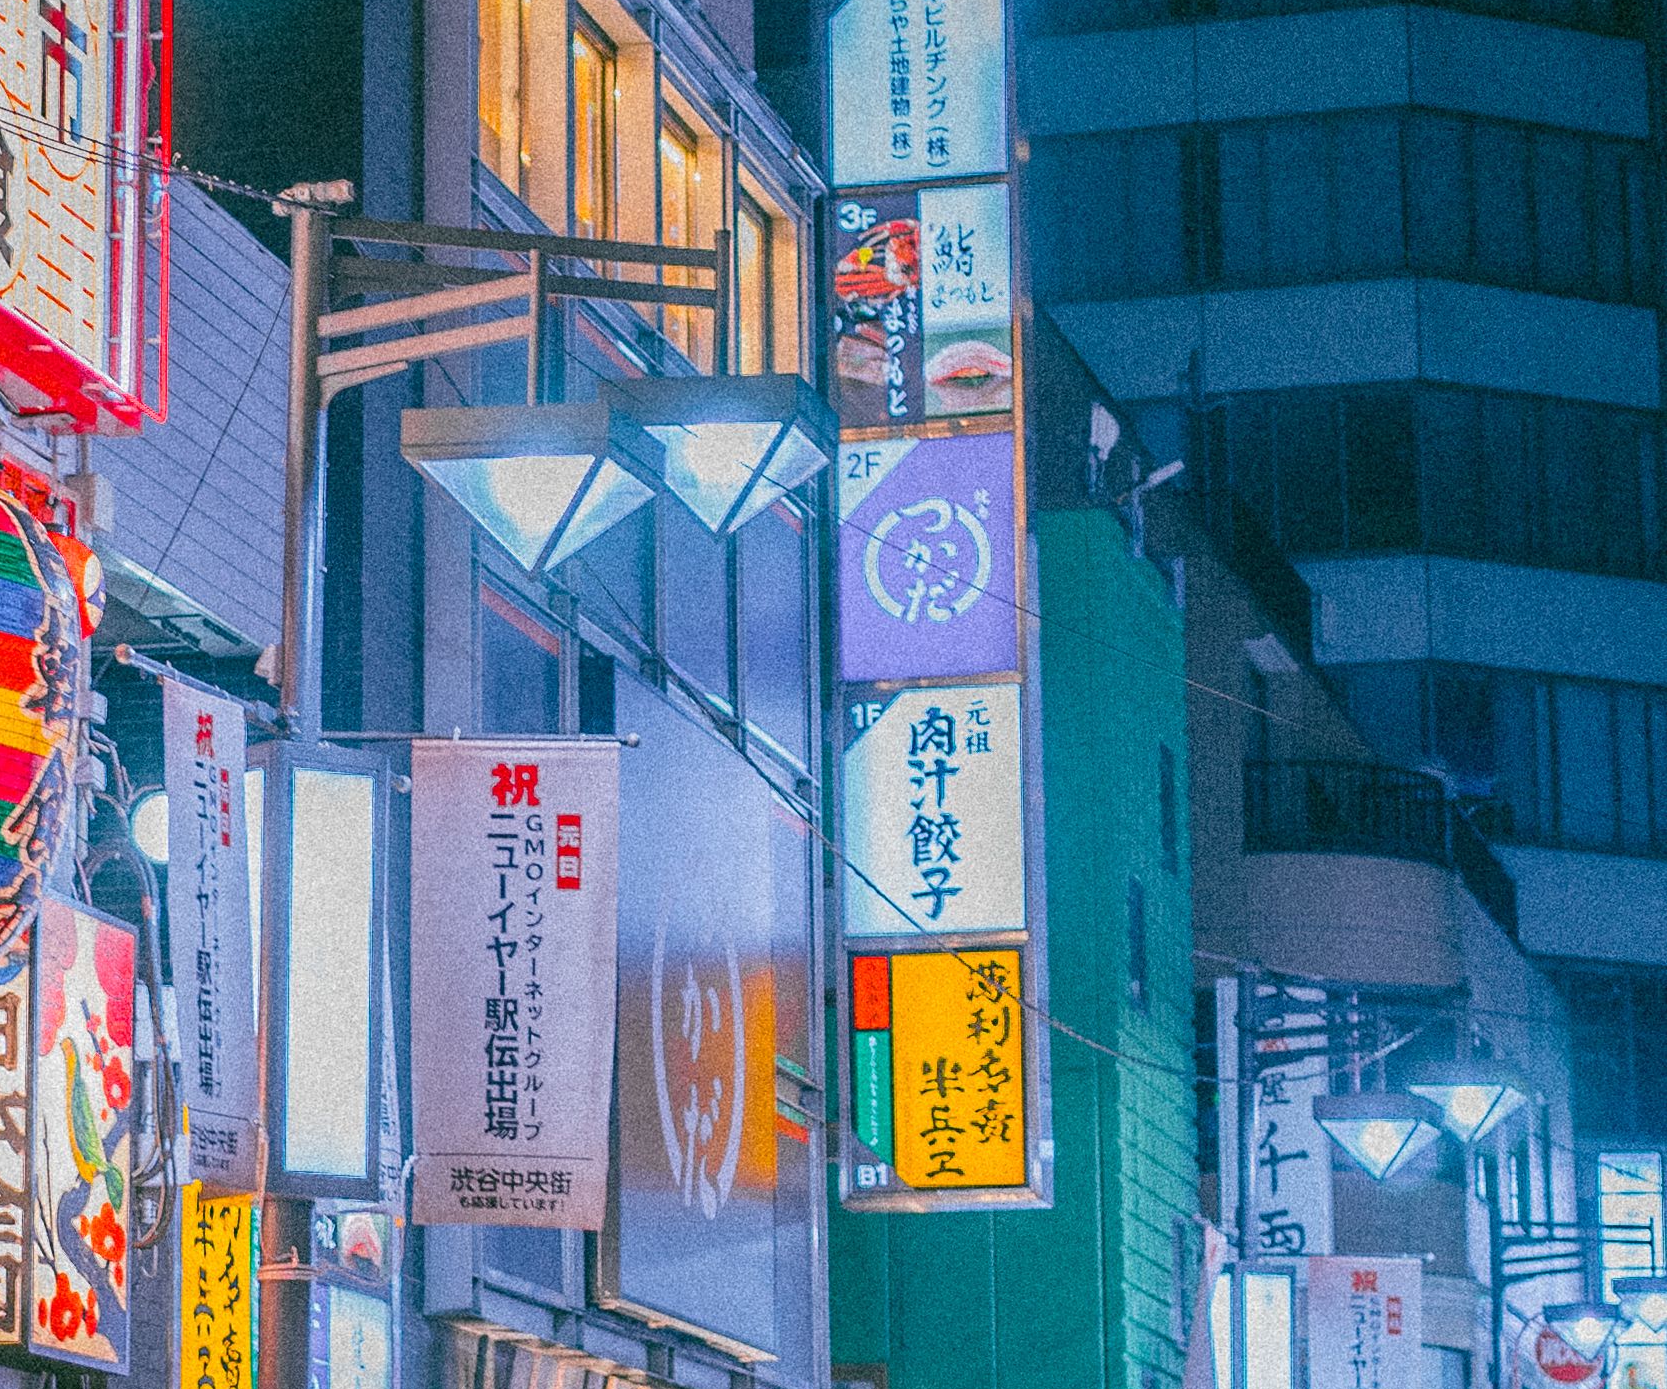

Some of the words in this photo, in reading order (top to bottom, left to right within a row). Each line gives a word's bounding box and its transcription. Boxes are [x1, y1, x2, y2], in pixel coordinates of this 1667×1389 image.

[840, 204, 877, 232] 3F
[847, 452, 881, 479] 2F
[964, 700, 993, 755] 元祖
[491, 762, 539, 807] 祝
[907, 707, 963, 922] 肉汁餃子
[558, 822, 582, 880] 元日
[484, 813, 520, 1139] ニューイヤー駅伝出場
[450, 1166, 572, 1195] 渋谷中央街
[857, 1163, 888, 1187] B1
